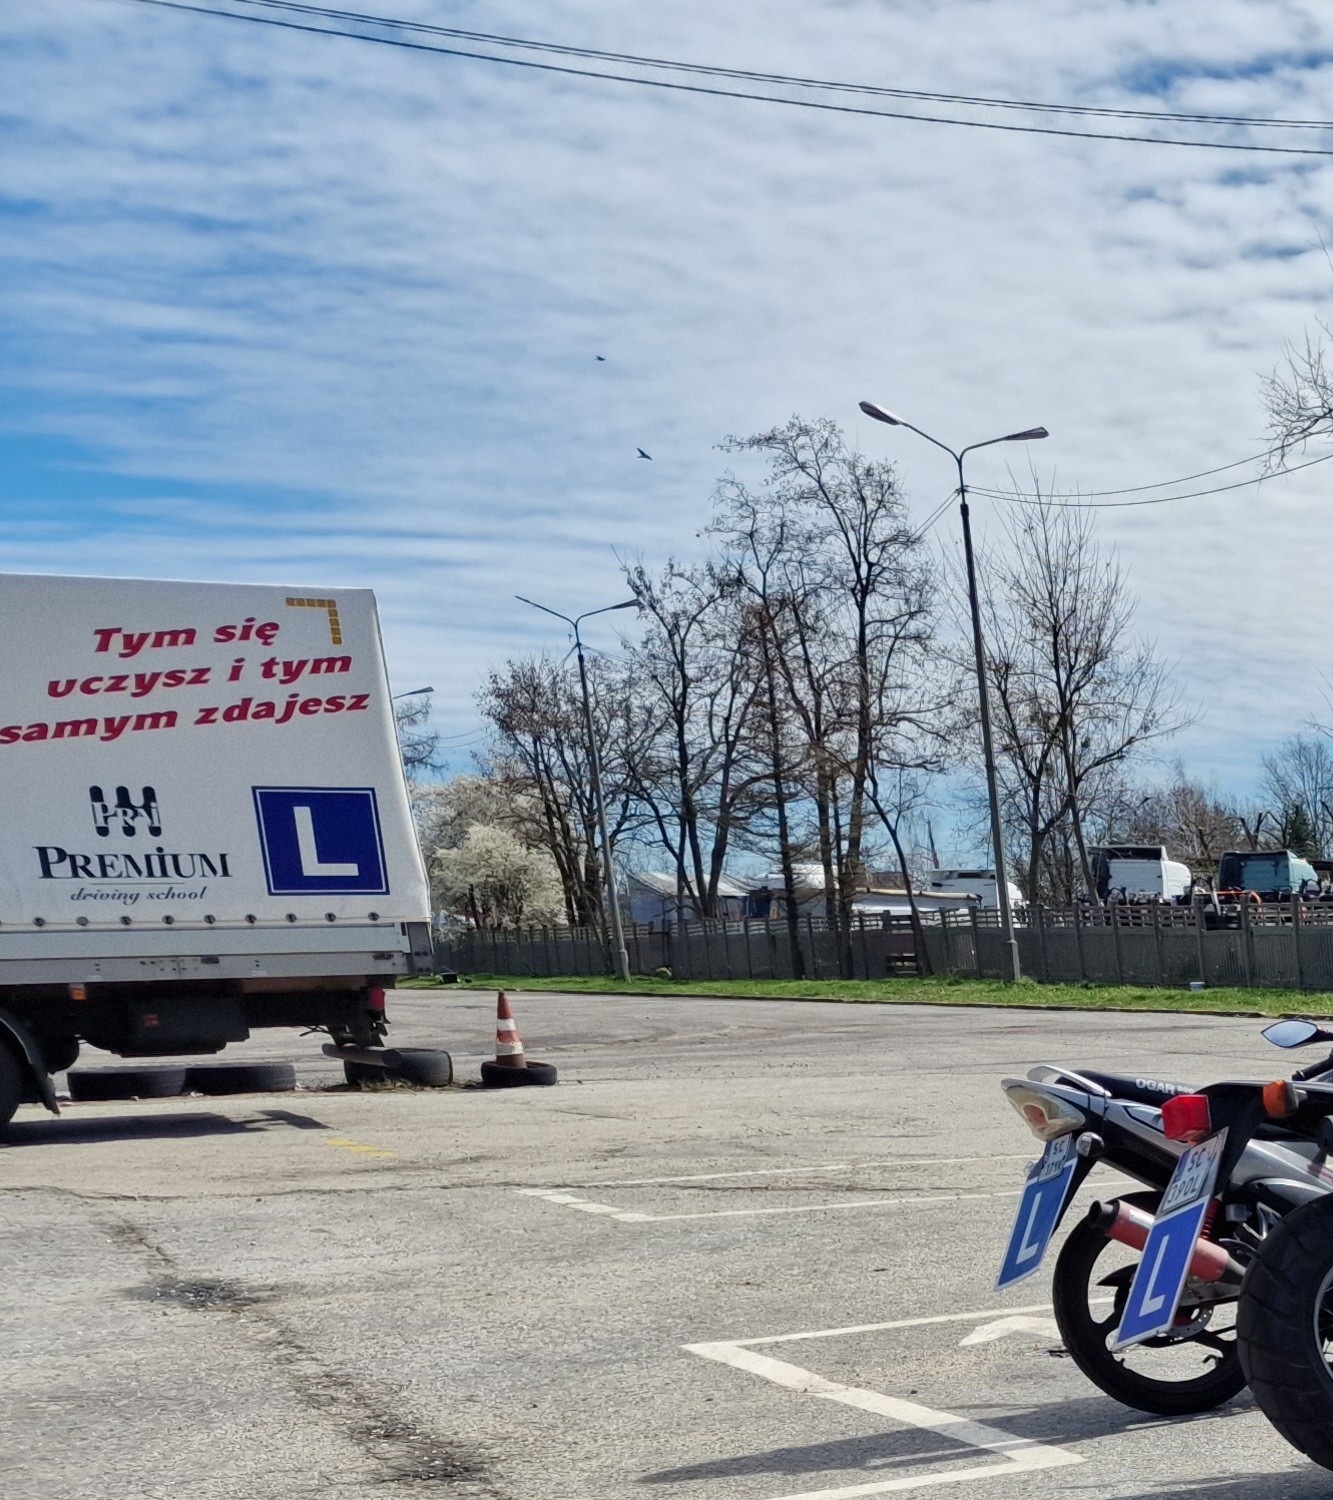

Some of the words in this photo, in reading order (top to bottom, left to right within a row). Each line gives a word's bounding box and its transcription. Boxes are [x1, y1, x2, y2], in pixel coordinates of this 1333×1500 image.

[94, 626, 197, 659] Tym
[213, 616, 280, 647] się
[47, 667, 212, 699] uczysz
[227, 657, 246, 683] i
[260, 655, 352, 685] tym
[0, 710, 178, 745] samym
[194, 693, 371, 725] zdajesz
[293, 806, 359, 877] L
[70, 887, 141, 906] driving
[146, 886, 208, 901] school
[1135, 1078, 1176, 1096] OGAR
[1188, 1147, 1206, 1172] SC
[1016, 1191, 1042, 1265] L
[1138, 1234, 1170, 1318] L
